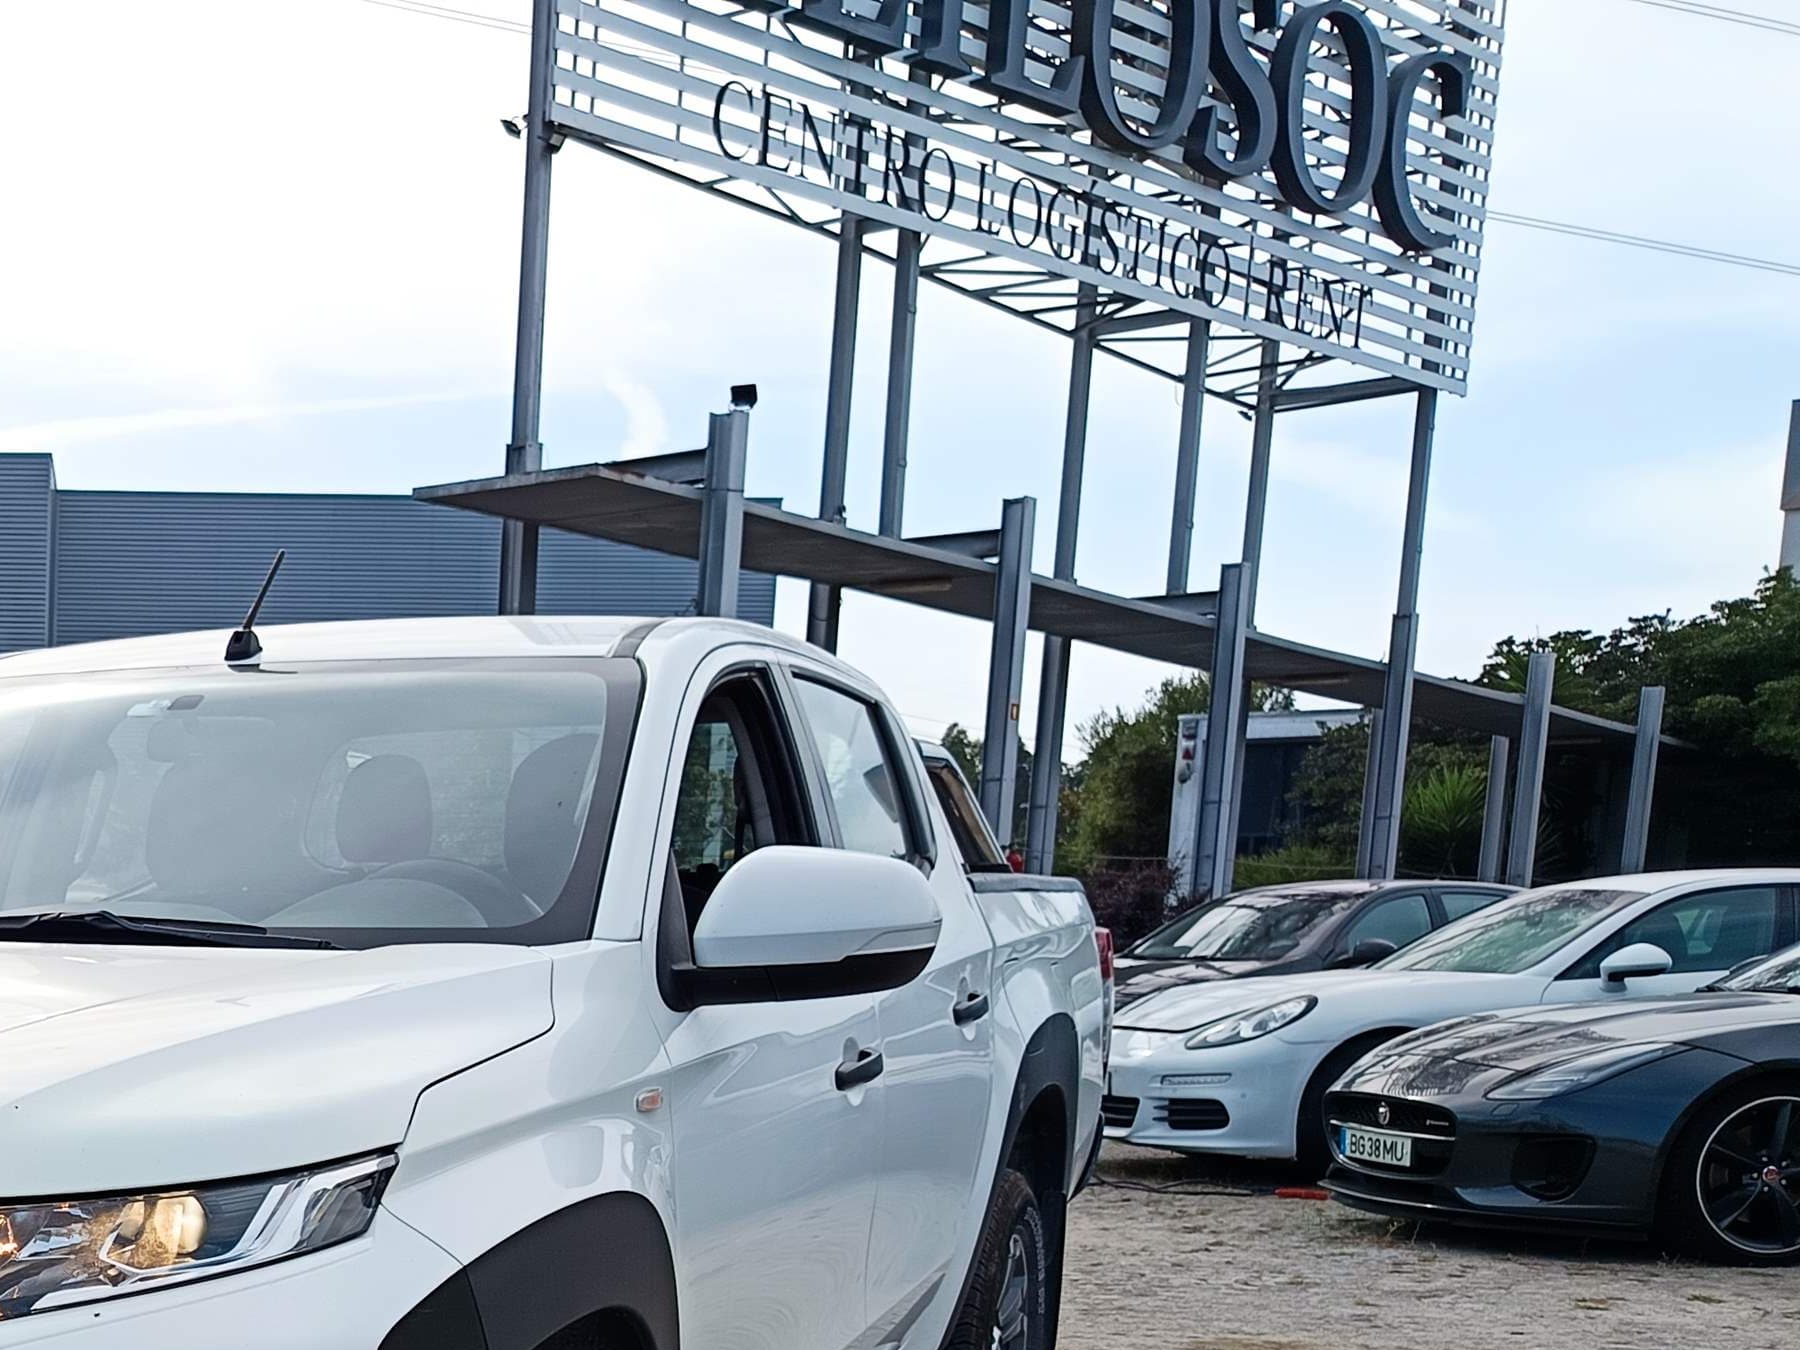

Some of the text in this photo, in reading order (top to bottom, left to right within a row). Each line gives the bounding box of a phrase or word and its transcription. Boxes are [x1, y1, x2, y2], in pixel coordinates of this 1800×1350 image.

[712, 80, 956, 222] CENTRO
[1262, 258, 1374, 348] RENT
[1349, 1133, 1405, 1161] BG38MU
